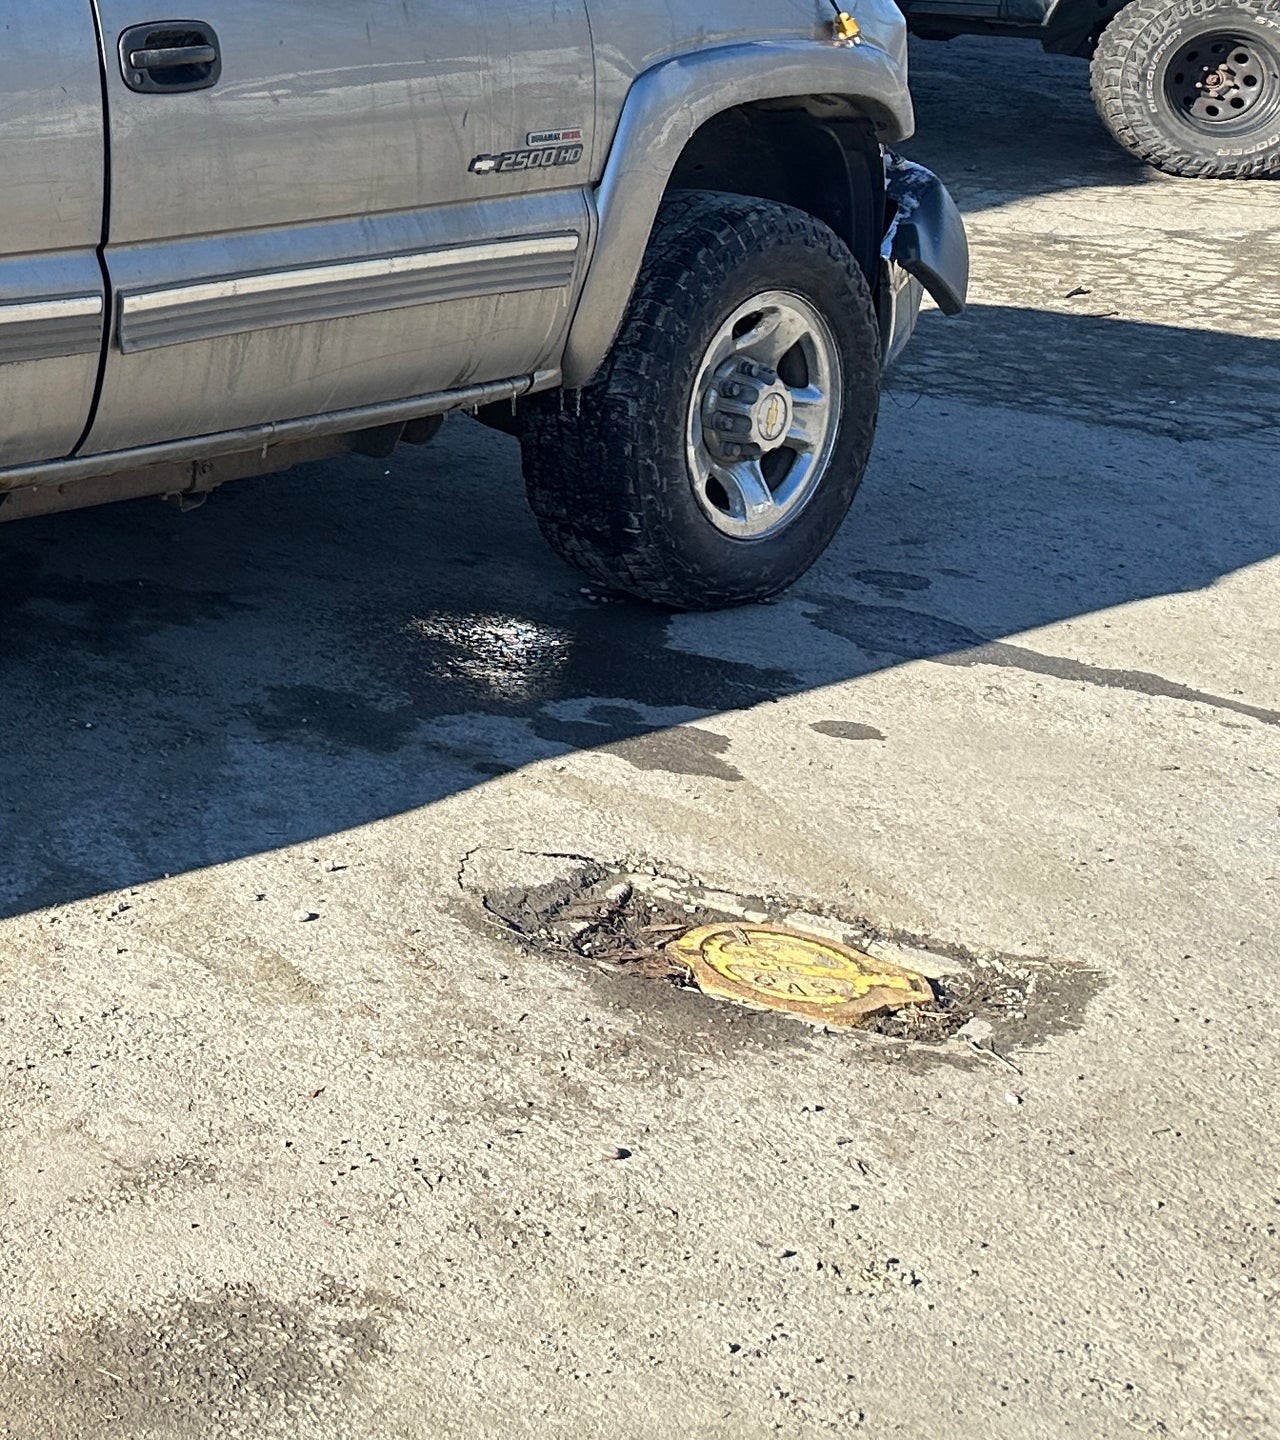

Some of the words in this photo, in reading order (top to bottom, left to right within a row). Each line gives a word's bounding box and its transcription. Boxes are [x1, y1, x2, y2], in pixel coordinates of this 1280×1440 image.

[1146, 28, 1182, 113] DISCOVERER
[531, 132, 560, 143] DURAMAX
[1216, 134, 1280, 157] OOPER
[500, 149, 557, 171] 2500
[558, 148, 582, 162] HD
